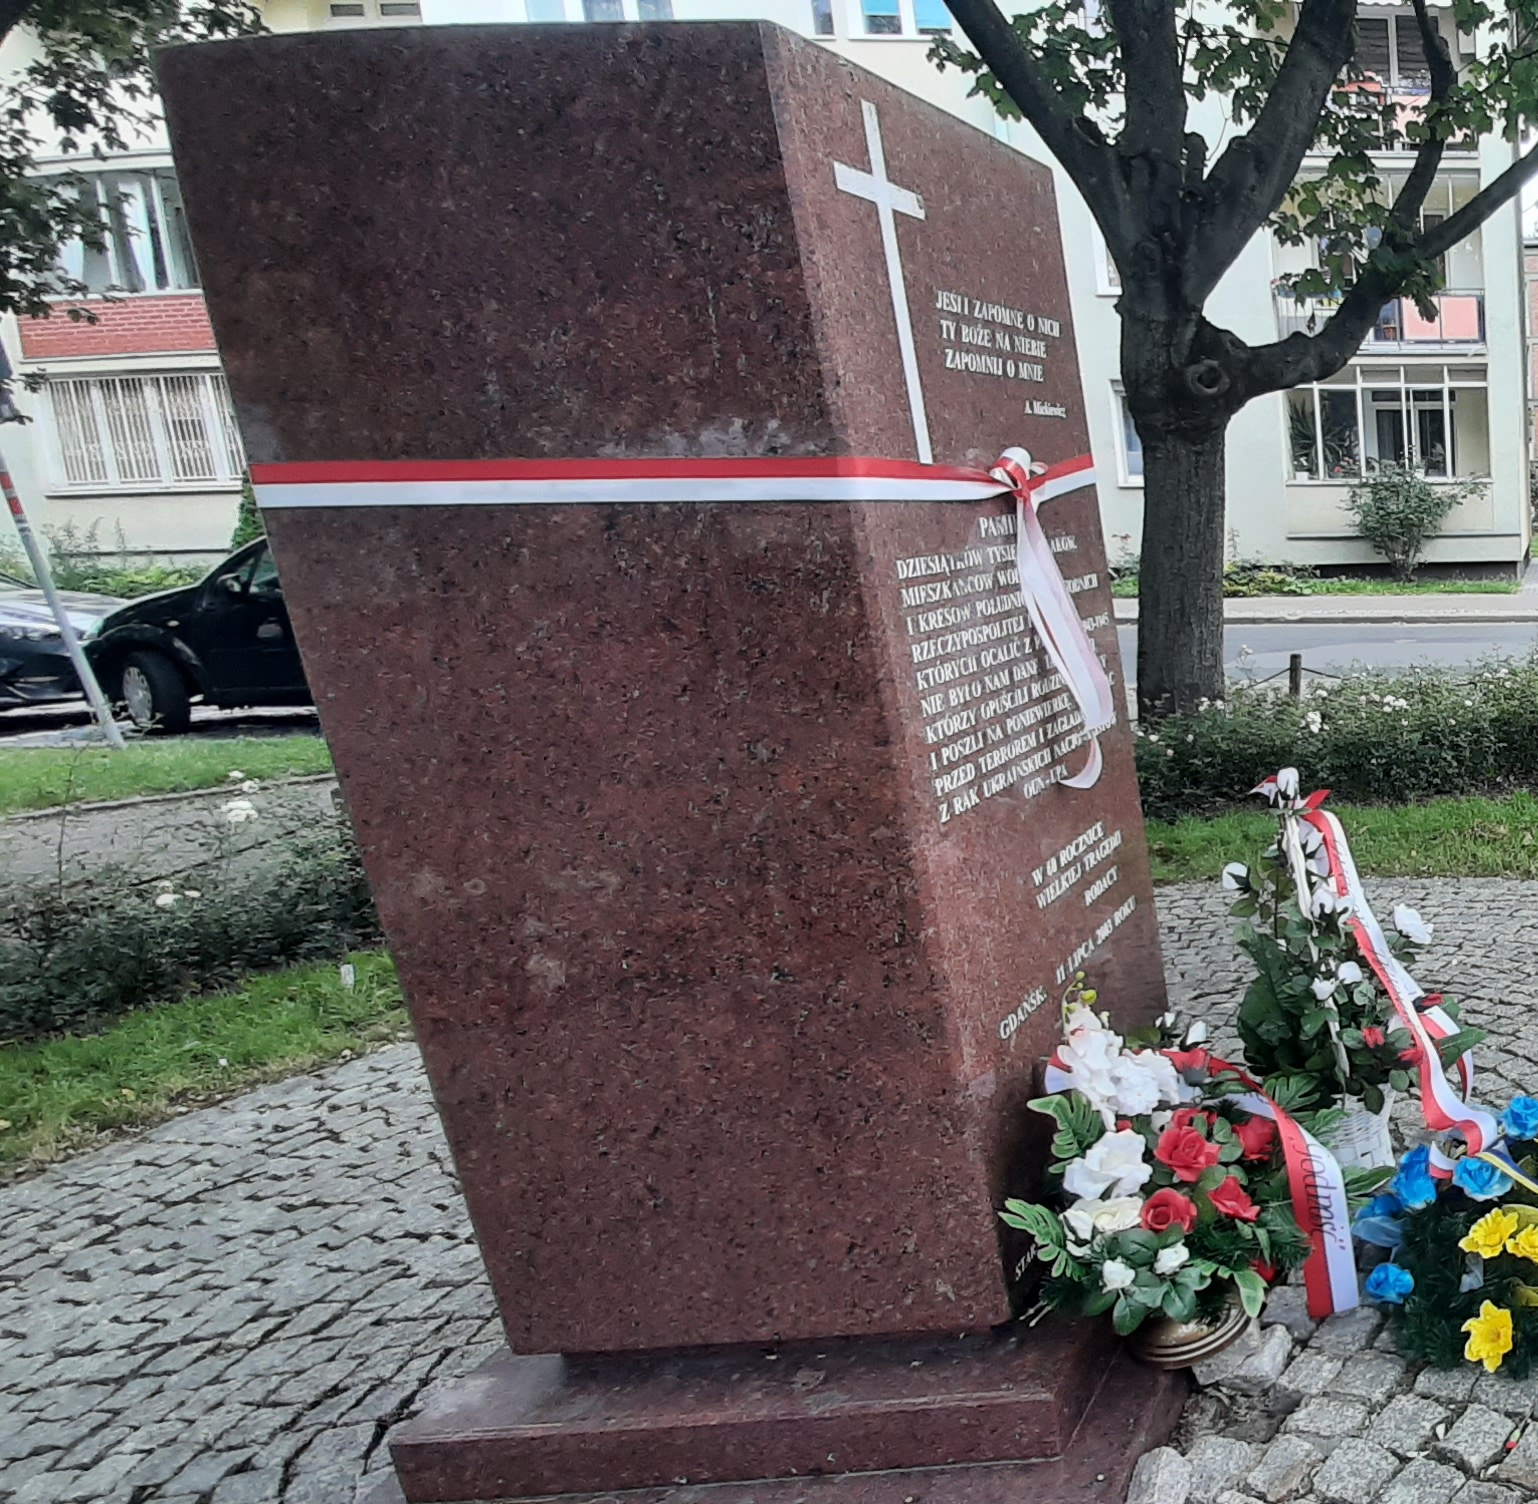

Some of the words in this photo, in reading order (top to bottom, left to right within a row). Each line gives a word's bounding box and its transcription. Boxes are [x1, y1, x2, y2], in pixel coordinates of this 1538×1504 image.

[940, 319, 956, 340] TY
[961, 323, 992, 347] BOŻE
[995, 331, 1011, 351] NA
[1013, 335, 1047, 358] NIEBIE
[1027, 314, 1035, 331] O
[1038, 317, 1060, 337] NICH
[945, 348, 1003, 375] ZAPOMNIJ
[1007, 359, 1015, 377] O
[1019, 362, 1044, 381] MNIE
[911, 616, 1025, 663] RZECZYPOSPOLITEJ
[916, 655, 979, 690] KTÓRYCH
[981, 637, 1022, 668] OCALIĆ
[1024, 637, 1032, 654] Z
[921, 693, 945, 717] NIE
[984, 668, 1011, 692] NAM
[926, 707, 977, 743] KTÓRZY
[930, 752, 938, 771] I
[941, 731, 984, 766] POSZLI
[986, 723, 1003, 744] NA
[935, 763, 975, 797] PRZED
[978, 732, 1037, 774] TERROREM
[1038, 727, 1045, 743] I
[939, 802, 950, 823] Z
[1031, 866, 1043, 886] W
[1046, 857, 1057, 876] 60
[1035, 862, 1082, 909] WIELKIEJ
[1083, 829, 1122, 871] TRAGEDII
[1084, 865, 1118, 906] RODACY
[1056, 964, 1066, 984] 11
[1067, 938, 1094, 973] LIPCA
[1095, 919, 1113, 944] 2003
[1113, 895, 1137, 926] ROKU
